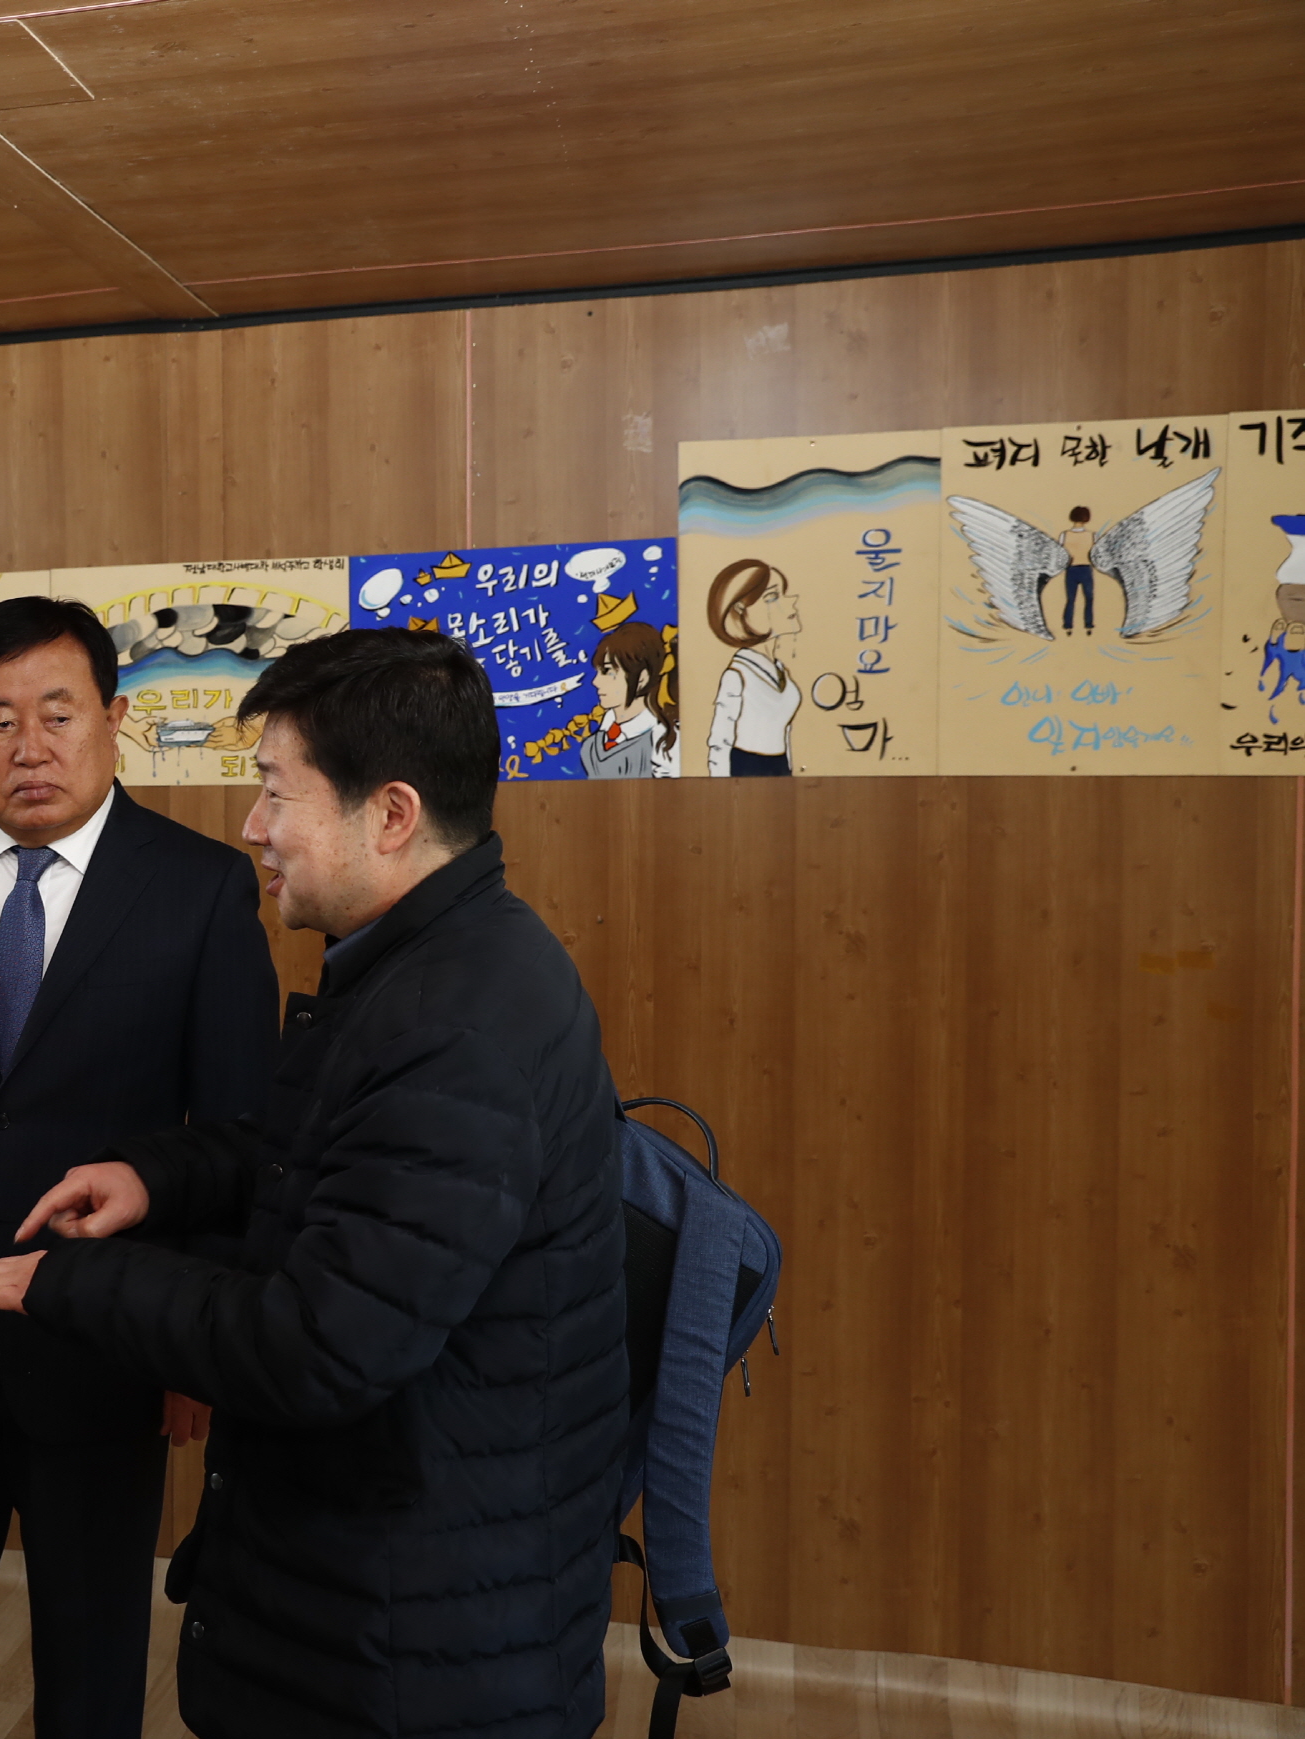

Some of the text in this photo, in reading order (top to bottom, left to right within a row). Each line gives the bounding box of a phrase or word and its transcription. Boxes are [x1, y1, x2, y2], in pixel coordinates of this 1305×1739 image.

[962, 424, 1211, 471] 펴지 못한 날개
[475, 559, 560, 597] 우리의
[132, 688, 234, 716] 우리가
